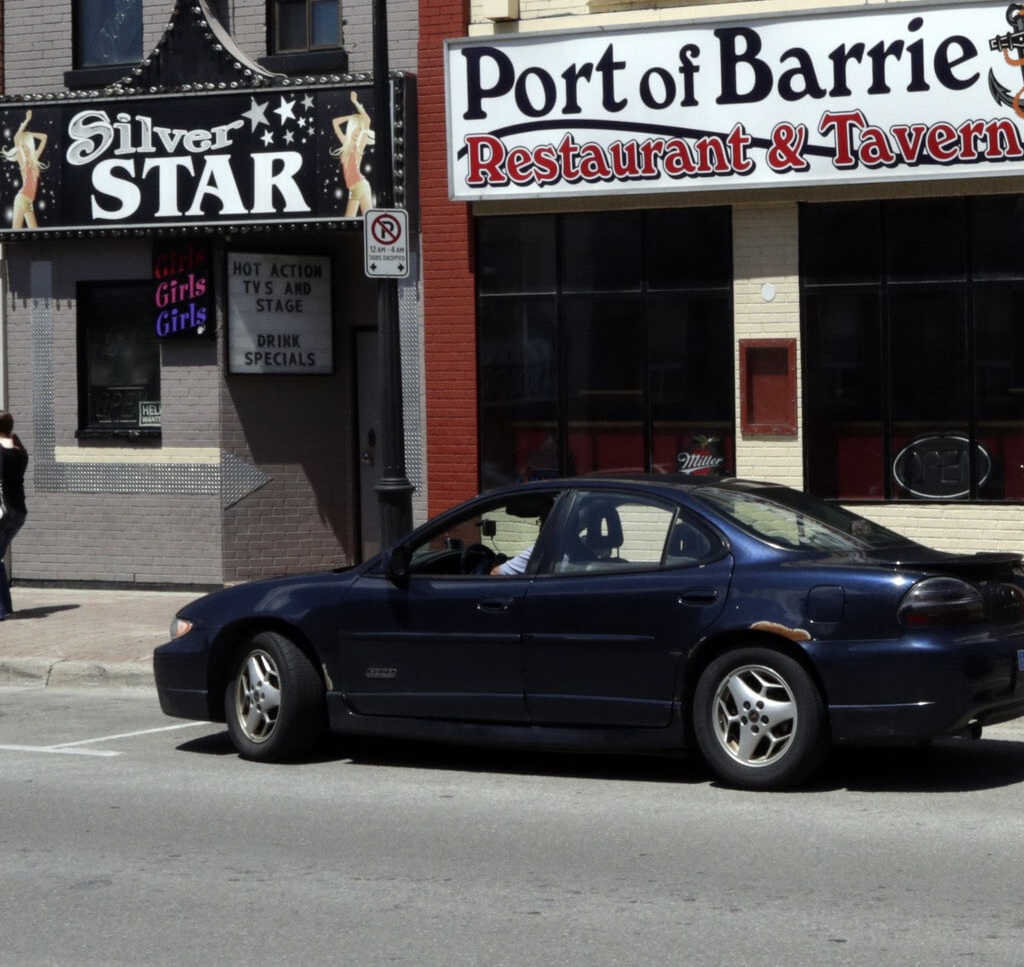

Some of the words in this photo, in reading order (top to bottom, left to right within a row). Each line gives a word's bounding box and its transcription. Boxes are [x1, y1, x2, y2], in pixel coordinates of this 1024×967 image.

[461, 43, 628, 120] Port
[639, 43, 700, 110] of
[714, 16, 981, 105] Barrie
[66, 110, 245, 166] Silver
[465, 122, 755, 187] Restaurant
[767, 121, 809, 172] &
[91, 151, 311, 220] STAR
[233, 261, 262, 276] HOT
[270, 263, 322, 278] ACTION
[155, 273, 207, 308] Girls
[284, 281, 311, 295] AND
[256, 298, 303, 313] STAGE
[155, 302, 208, 337] Girls
[257, 334, 301, 348] DRINK
[244, 352, 316, 366] SPECIALS
[677, 452, 724, 470] Miller
